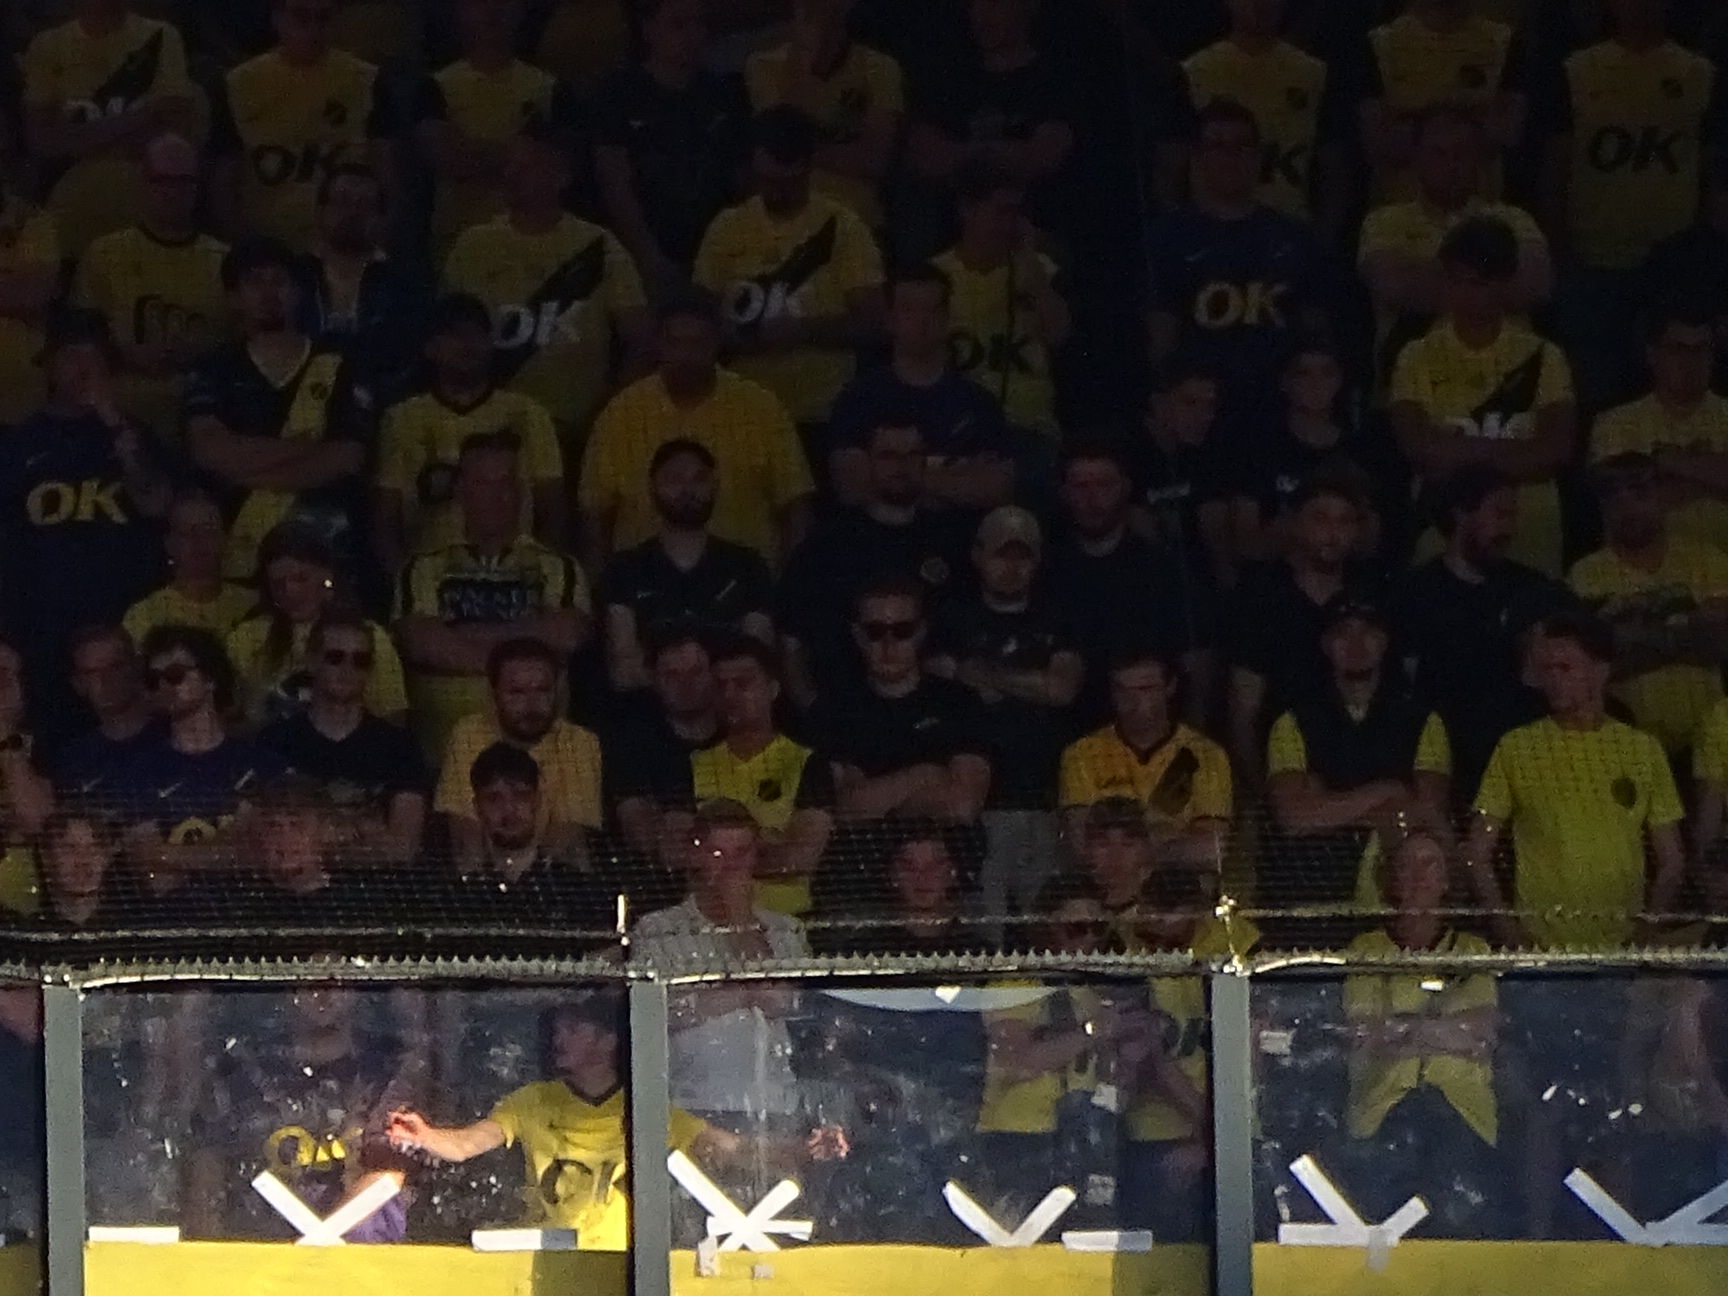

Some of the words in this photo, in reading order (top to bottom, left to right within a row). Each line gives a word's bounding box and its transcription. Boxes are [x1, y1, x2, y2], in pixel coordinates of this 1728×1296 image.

[1587, 126, 1680, 172] OK
[491, 304, 582, 350] OK
[1194, 280, 1290, 329] OK
[25, 479, 130, 526] OK
